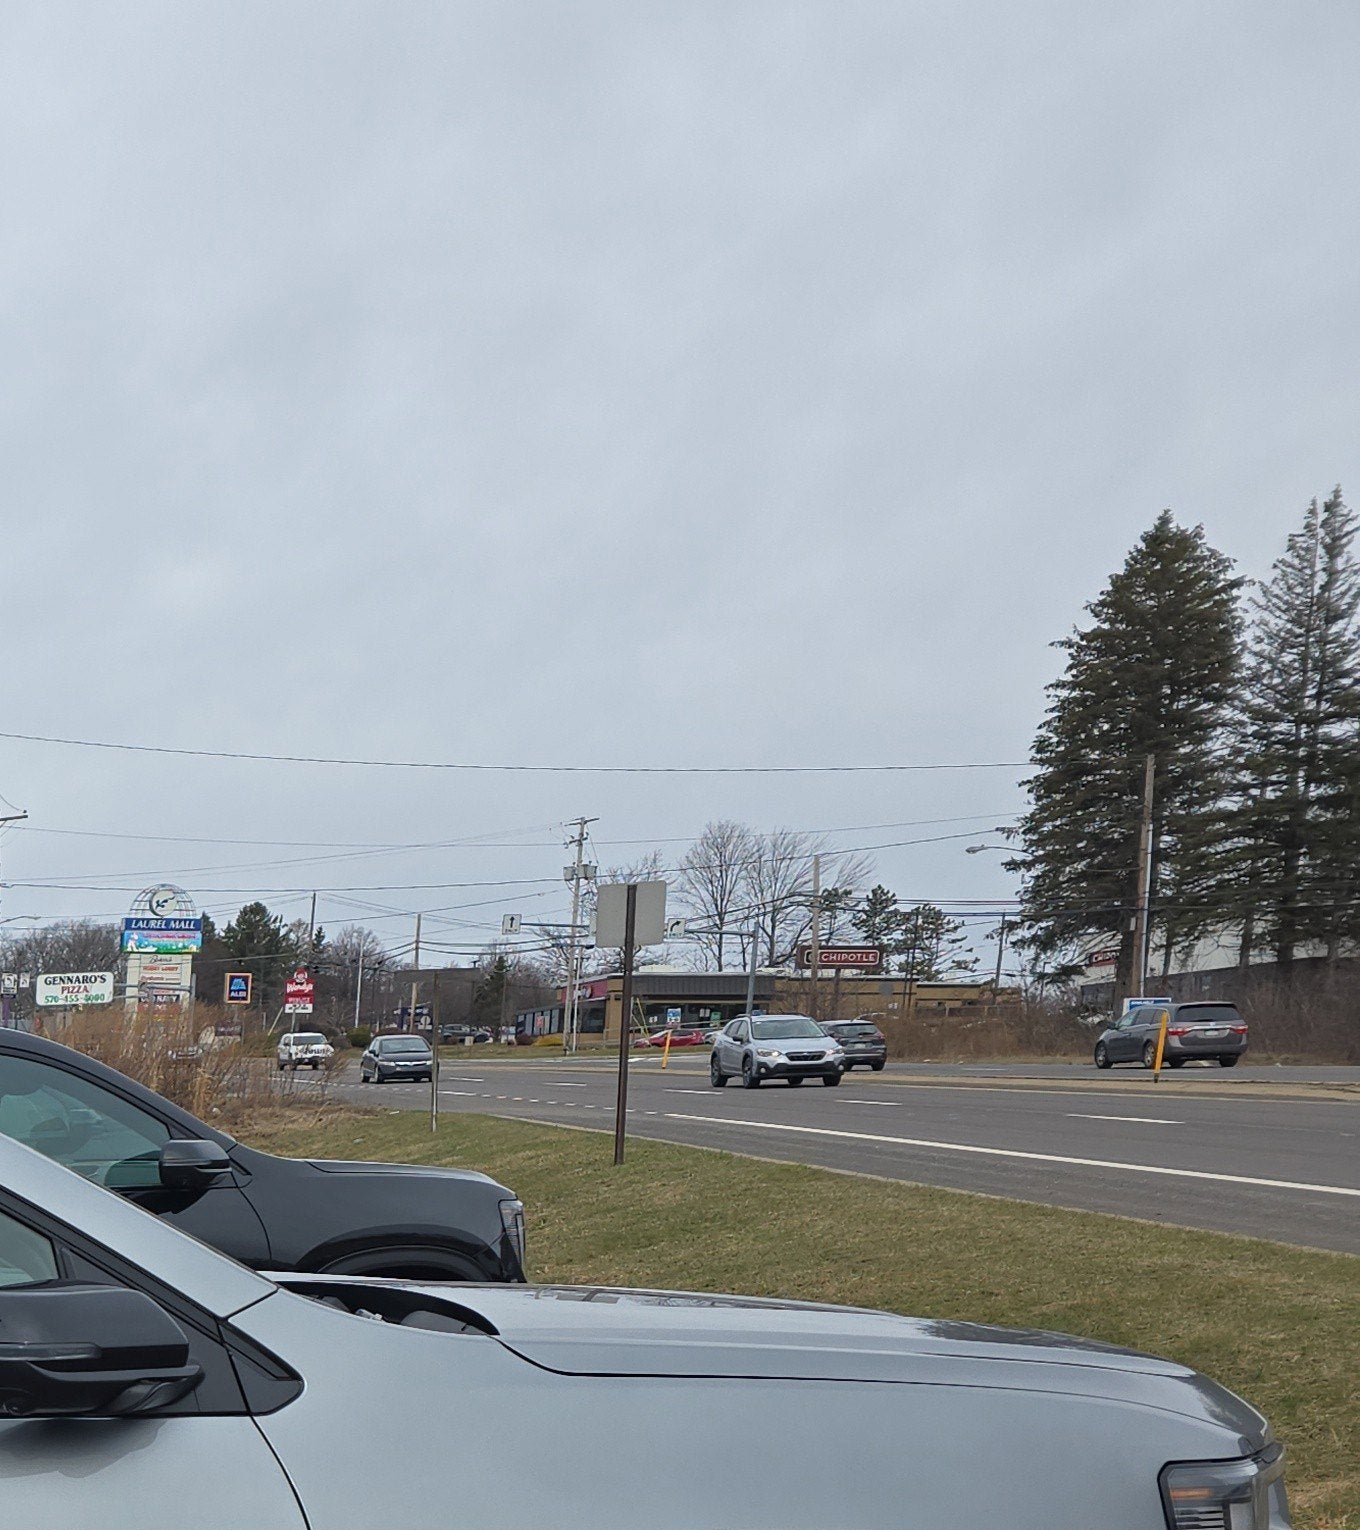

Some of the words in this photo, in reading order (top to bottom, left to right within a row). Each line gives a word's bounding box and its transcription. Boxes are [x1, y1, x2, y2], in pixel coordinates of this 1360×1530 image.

[131, 920, 166, 929] LAUREL
[168, 920, 196, 929] MALL
[821, 953, 875, 962] CHIPOTLE
[44, 974, 107, 986] GENNARO'S
[61, 985, 89, 995] PIZZA
